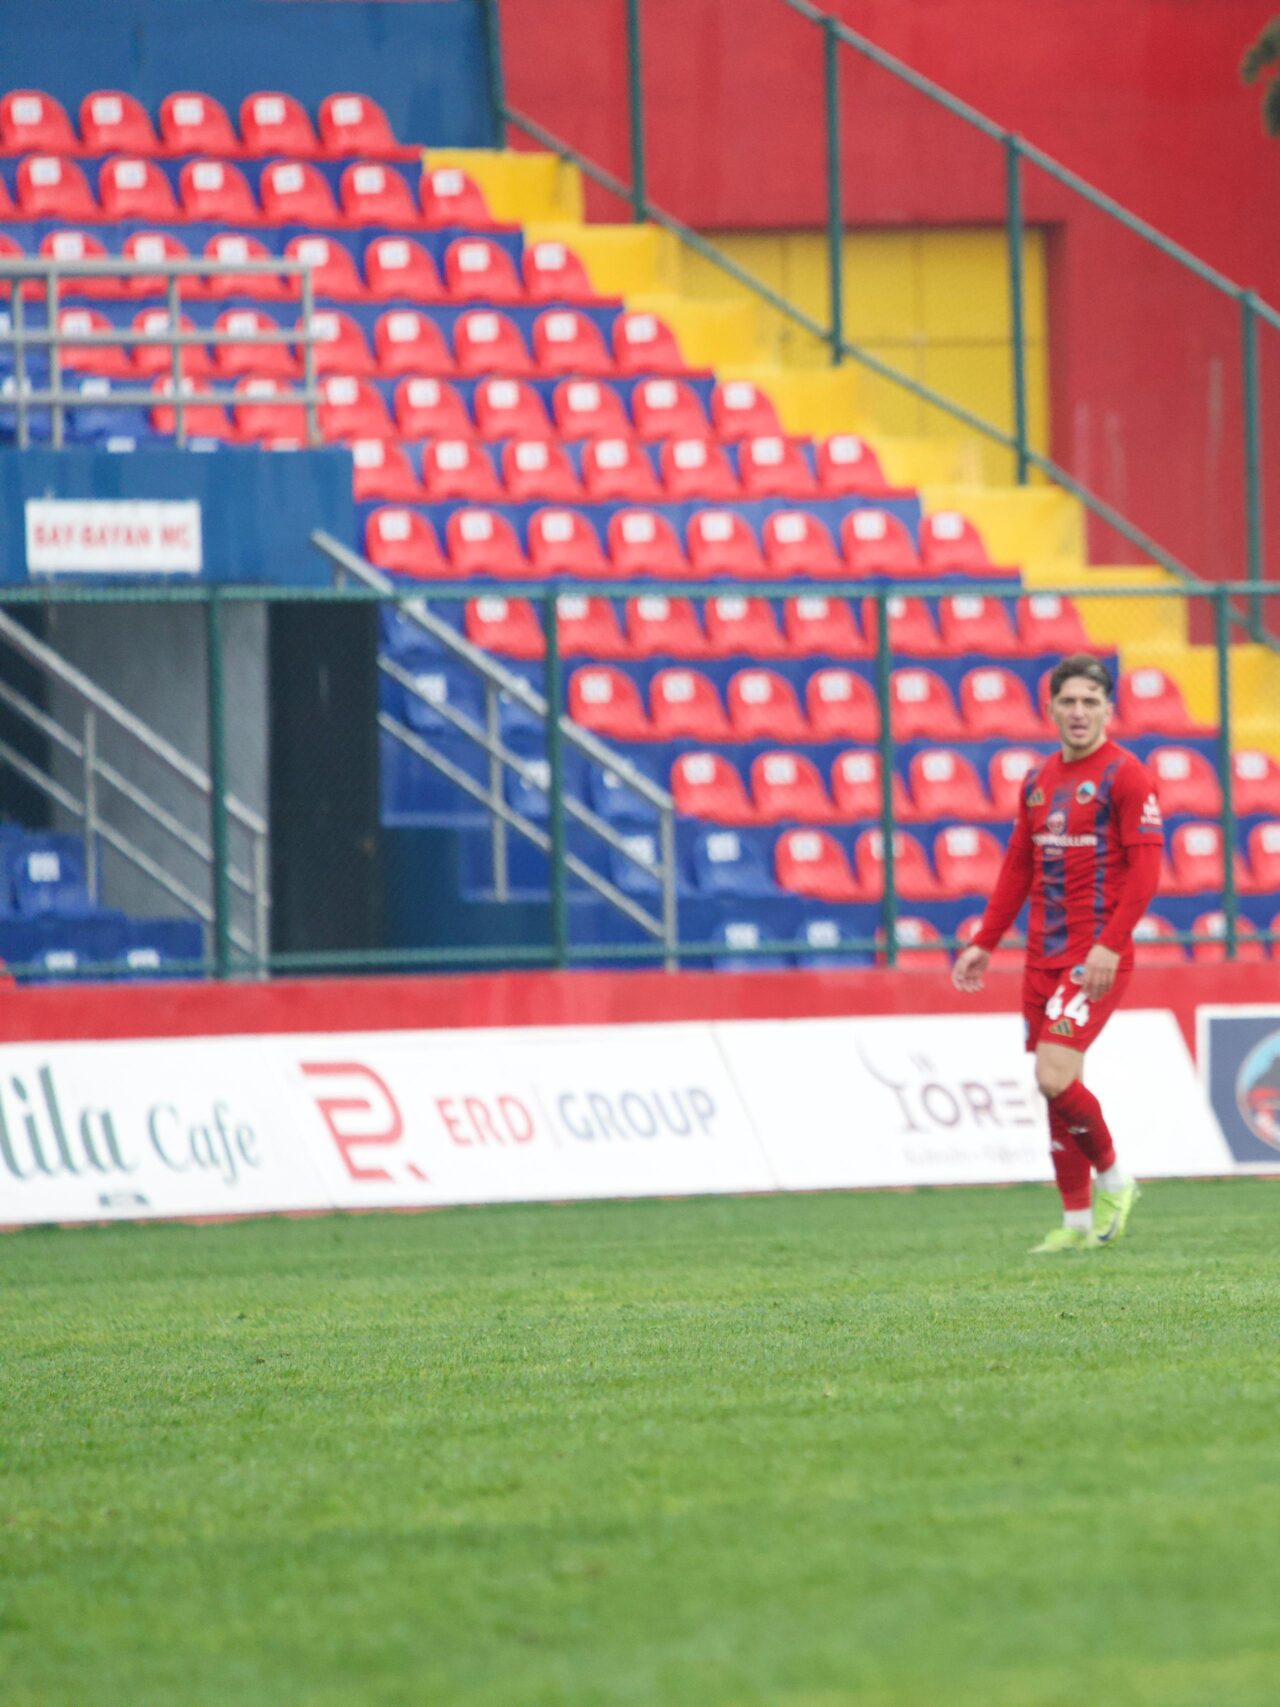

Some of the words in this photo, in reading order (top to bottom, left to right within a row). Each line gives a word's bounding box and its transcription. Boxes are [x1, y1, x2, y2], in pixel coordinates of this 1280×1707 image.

[147, 1098, 262, 1187] Cafe
[434, 1095, 535, 1147] ERD
[557, 1086, 717, 1143] GROUP
